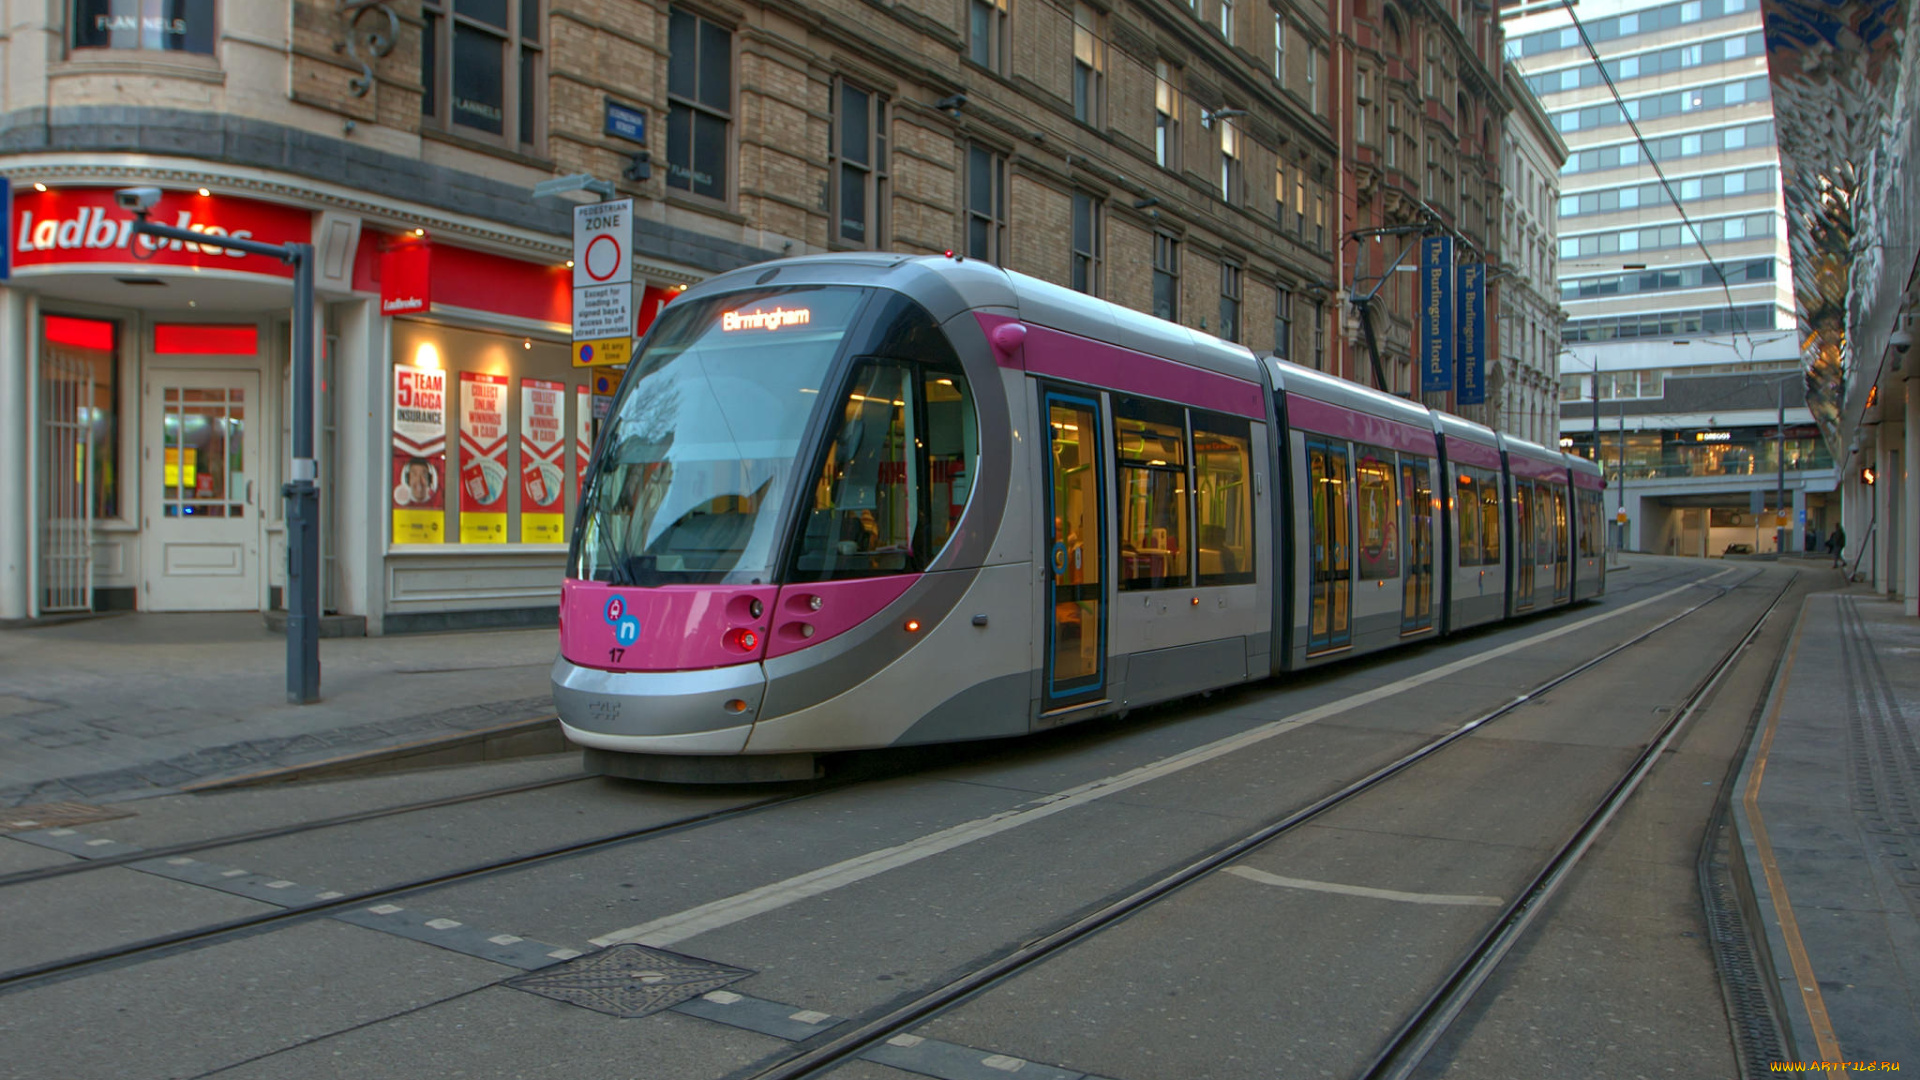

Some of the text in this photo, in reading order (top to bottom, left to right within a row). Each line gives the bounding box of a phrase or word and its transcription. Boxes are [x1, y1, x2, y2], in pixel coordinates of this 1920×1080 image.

[95, 14, 187, 35] FLANNELS
[578, 202, 628, 217] PEDESTRIAN
[585, 214, 620, 231] ZONE
[1431, 240, 1443, 265] The
[1465, 267, 1476, 289] The
[584, 287, 620, 299] Except for
[384, 296, 422, 311] Ladbrokes
[585, 299, 610, 308] loading
[1428, 268, 1443, 336] Burlington
[578, 309, 601, 319] signed
[602, 307, 619, 316] bays
[580, 319, 602, 328] access
[613, 315, 624, 324] off
[722, 306, 811, 332] Birmingham
[575, 326, 629, 337] street premises
[1463, 292, 1476, 354] Burlington
[602, 343, 610, 351] At
[1431, 339, 1443, 374] Hotel
[1465, 356, 1476, 389] Hotel
[397, 370, 443, 408] 5 TEAM
[413, 391, 443, 411] ACCA
[397, 408, 442, 425] INSURANCE
[609, 647, 626, 664] 17
